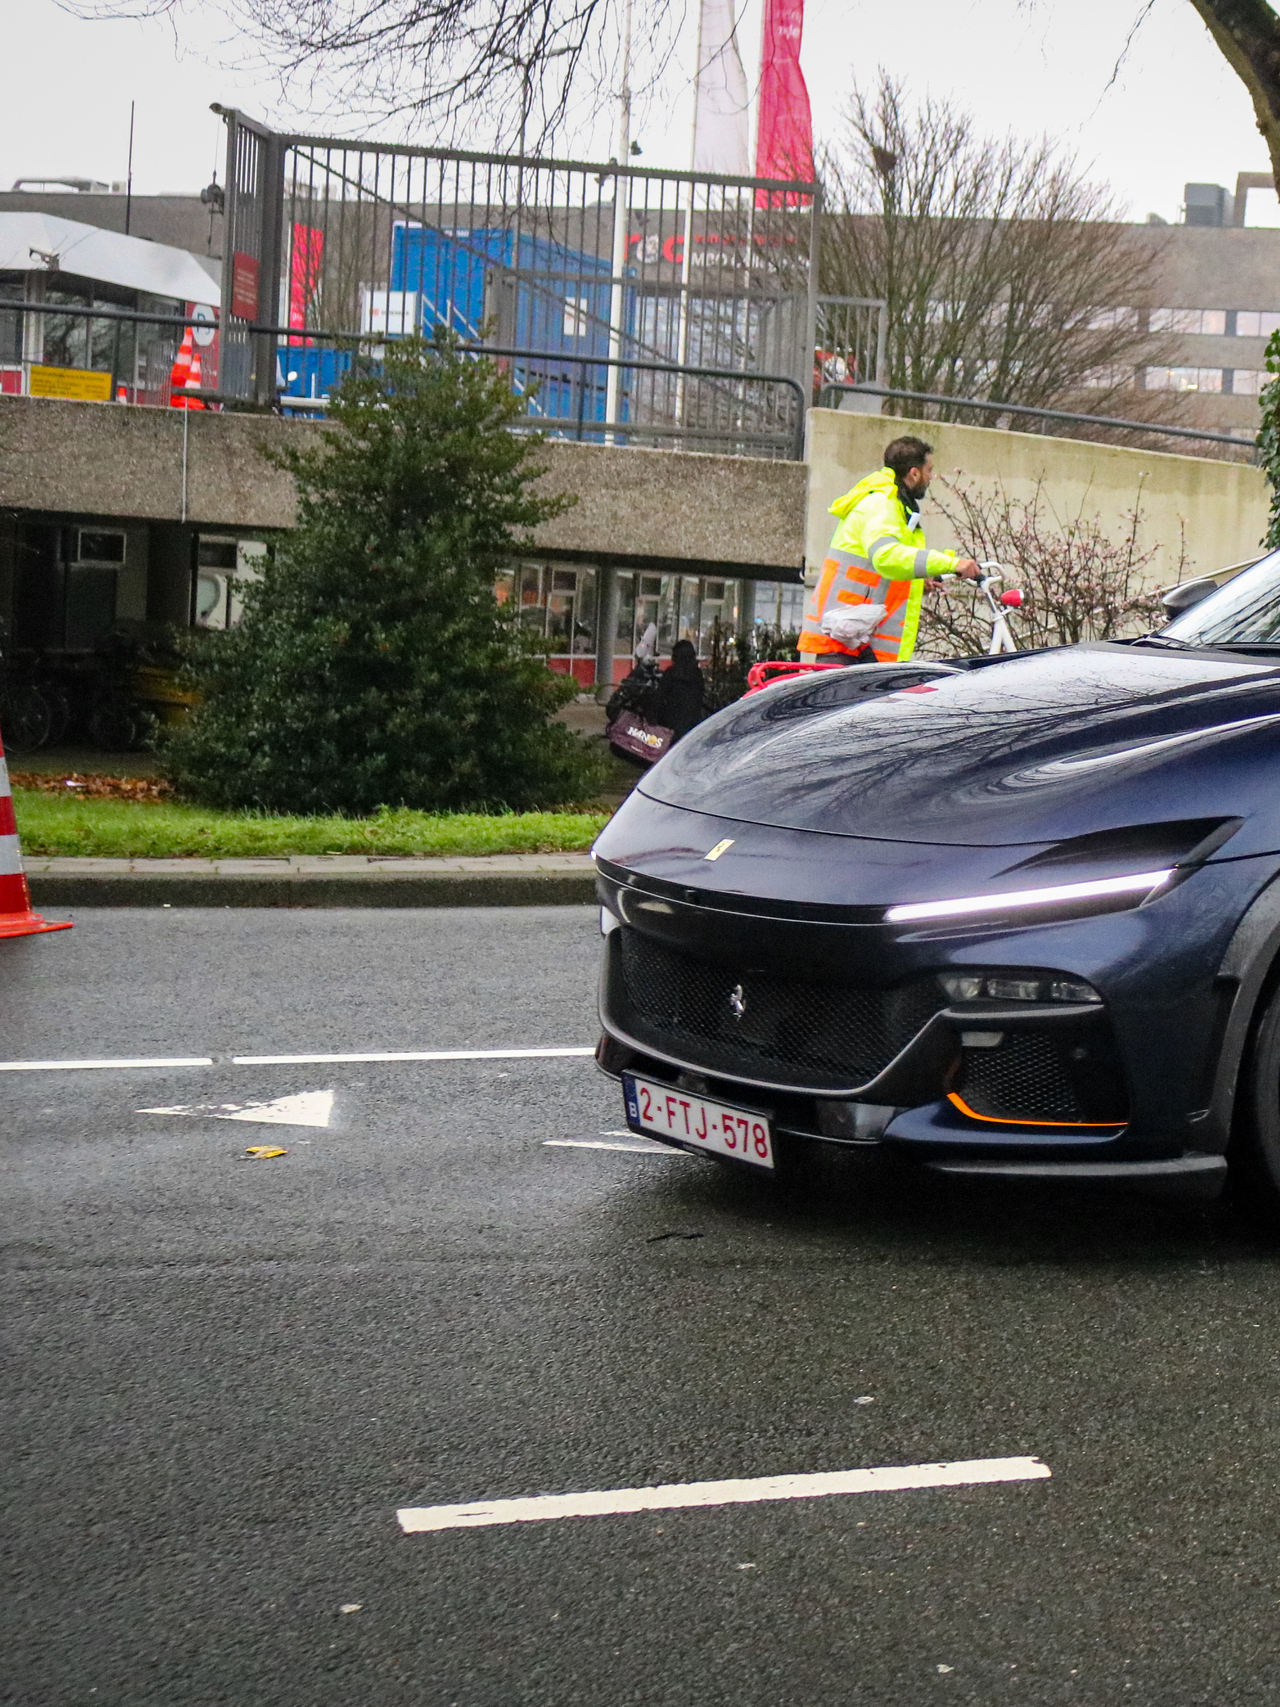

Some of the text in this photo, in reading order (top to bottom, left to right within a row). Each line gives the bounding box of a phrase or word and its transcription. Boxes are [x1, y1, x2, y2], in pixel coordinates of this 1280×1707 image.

[691, 251, 728, 266] MBO
[628, 1101, 638, 1118] B
[640, 1087, 768, 1158] 2-FTJ-578
